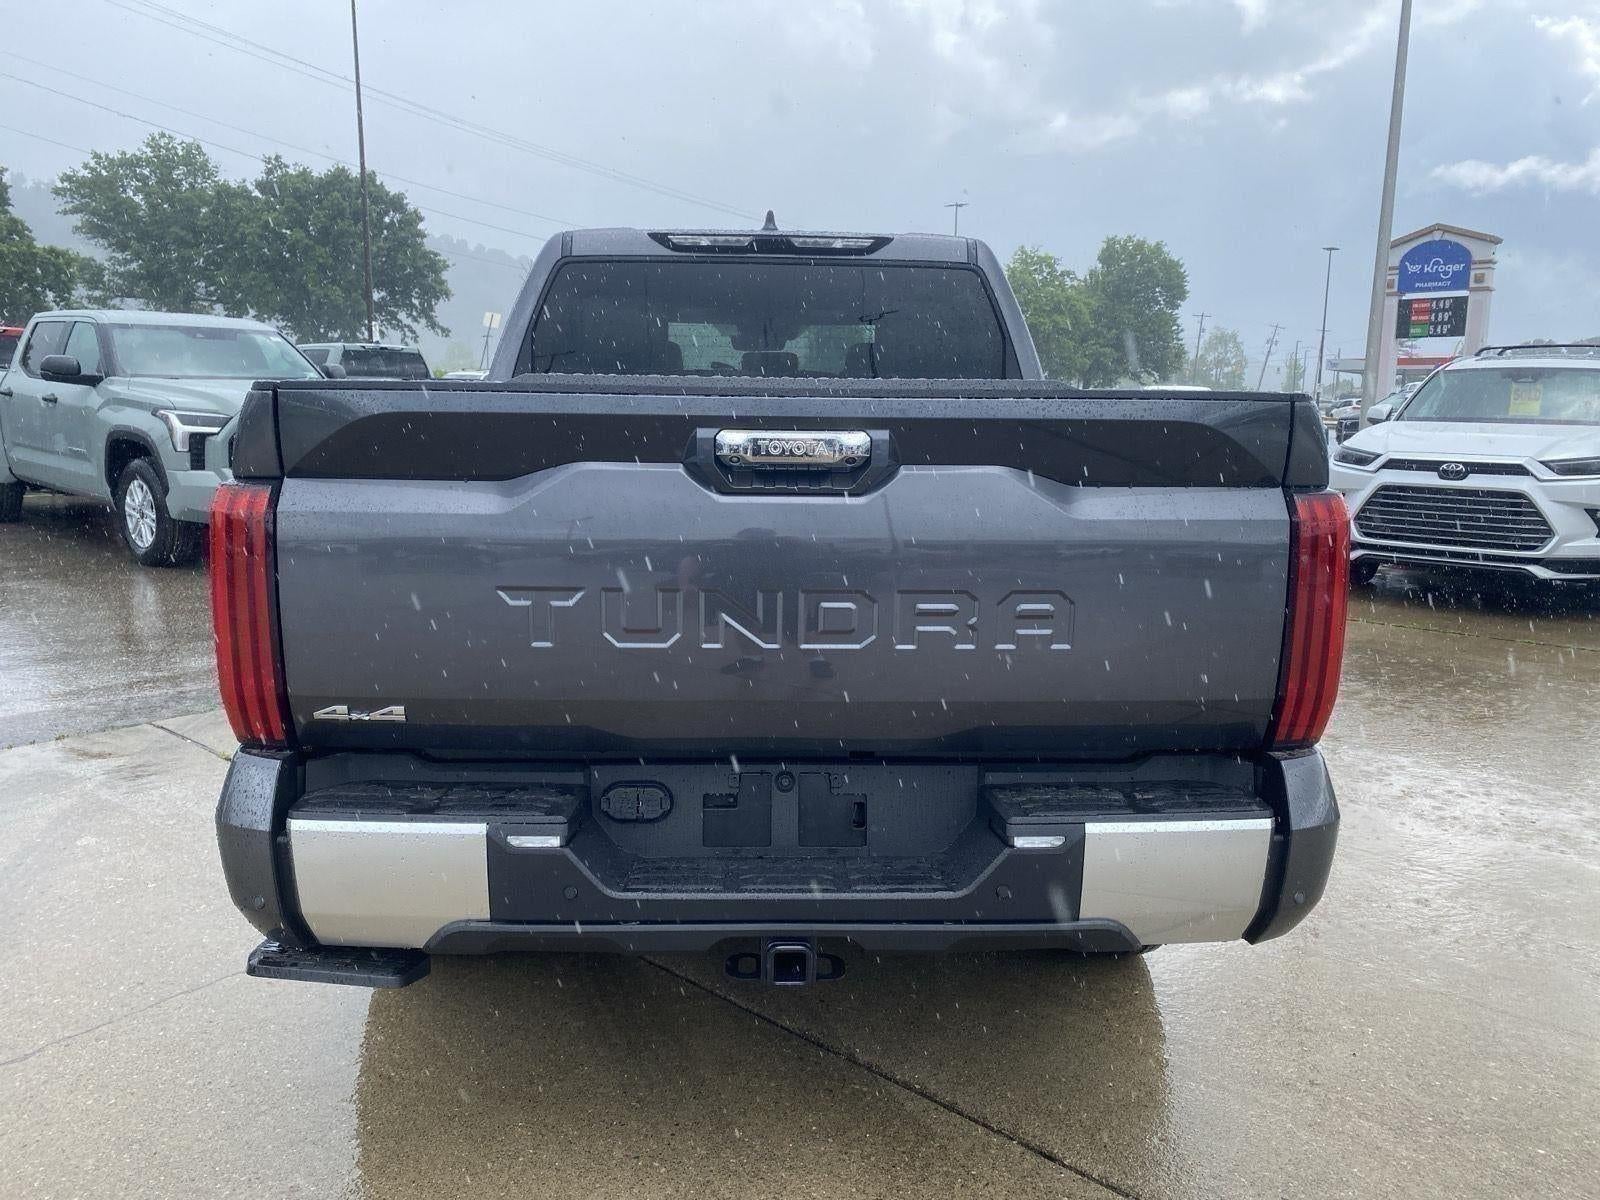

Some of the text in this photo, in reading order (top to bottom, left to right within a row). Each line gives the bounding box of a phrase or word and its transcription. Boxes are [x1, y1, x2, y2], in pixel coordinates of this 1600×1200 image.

[1424, 258, 1465, 279] Kroger
[758, 440, 829, 455] TOYOTA
[496, 585, 1075, 650] TUNDRA
